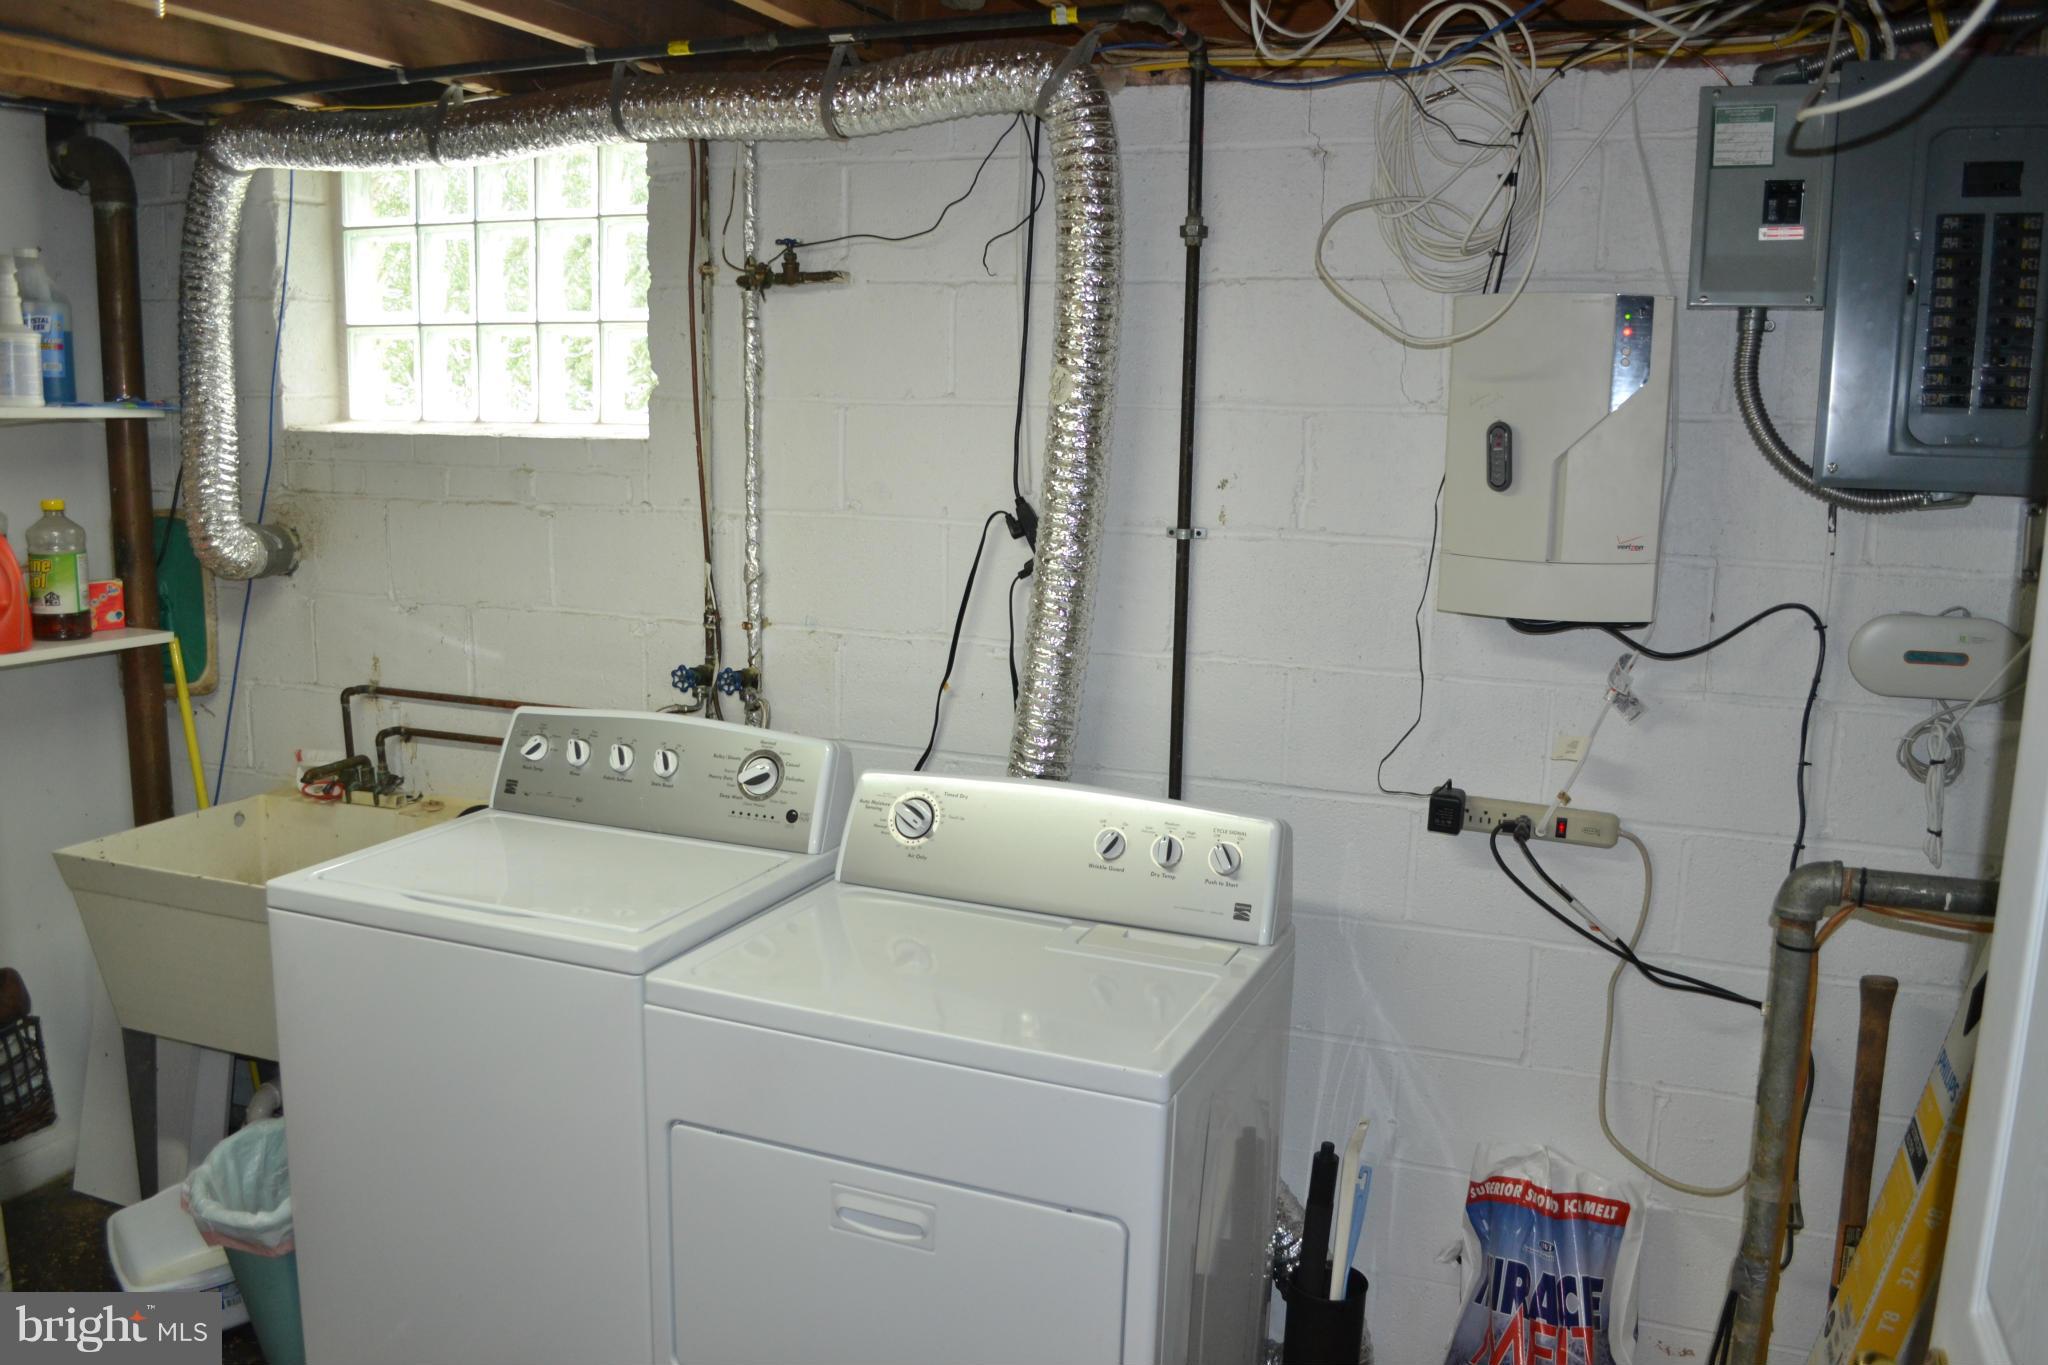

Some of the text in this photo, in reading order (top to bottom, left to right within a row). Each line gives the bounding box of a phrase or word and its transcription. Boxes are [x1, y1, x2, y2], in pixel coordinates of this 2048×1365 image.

[1229, 829, 1247, 837] SIGNAL
[1108, 865, 1125, 873] Guard
[1150, 871, 1176, 880] Dry Temp
[1204, 878, 1217, 886] Push
[1225, 881, 1239, 889] Start
[1470, 1182, 1524, 1199] SUPERIOR
[1877, 1309, 1901, 1333] T8
